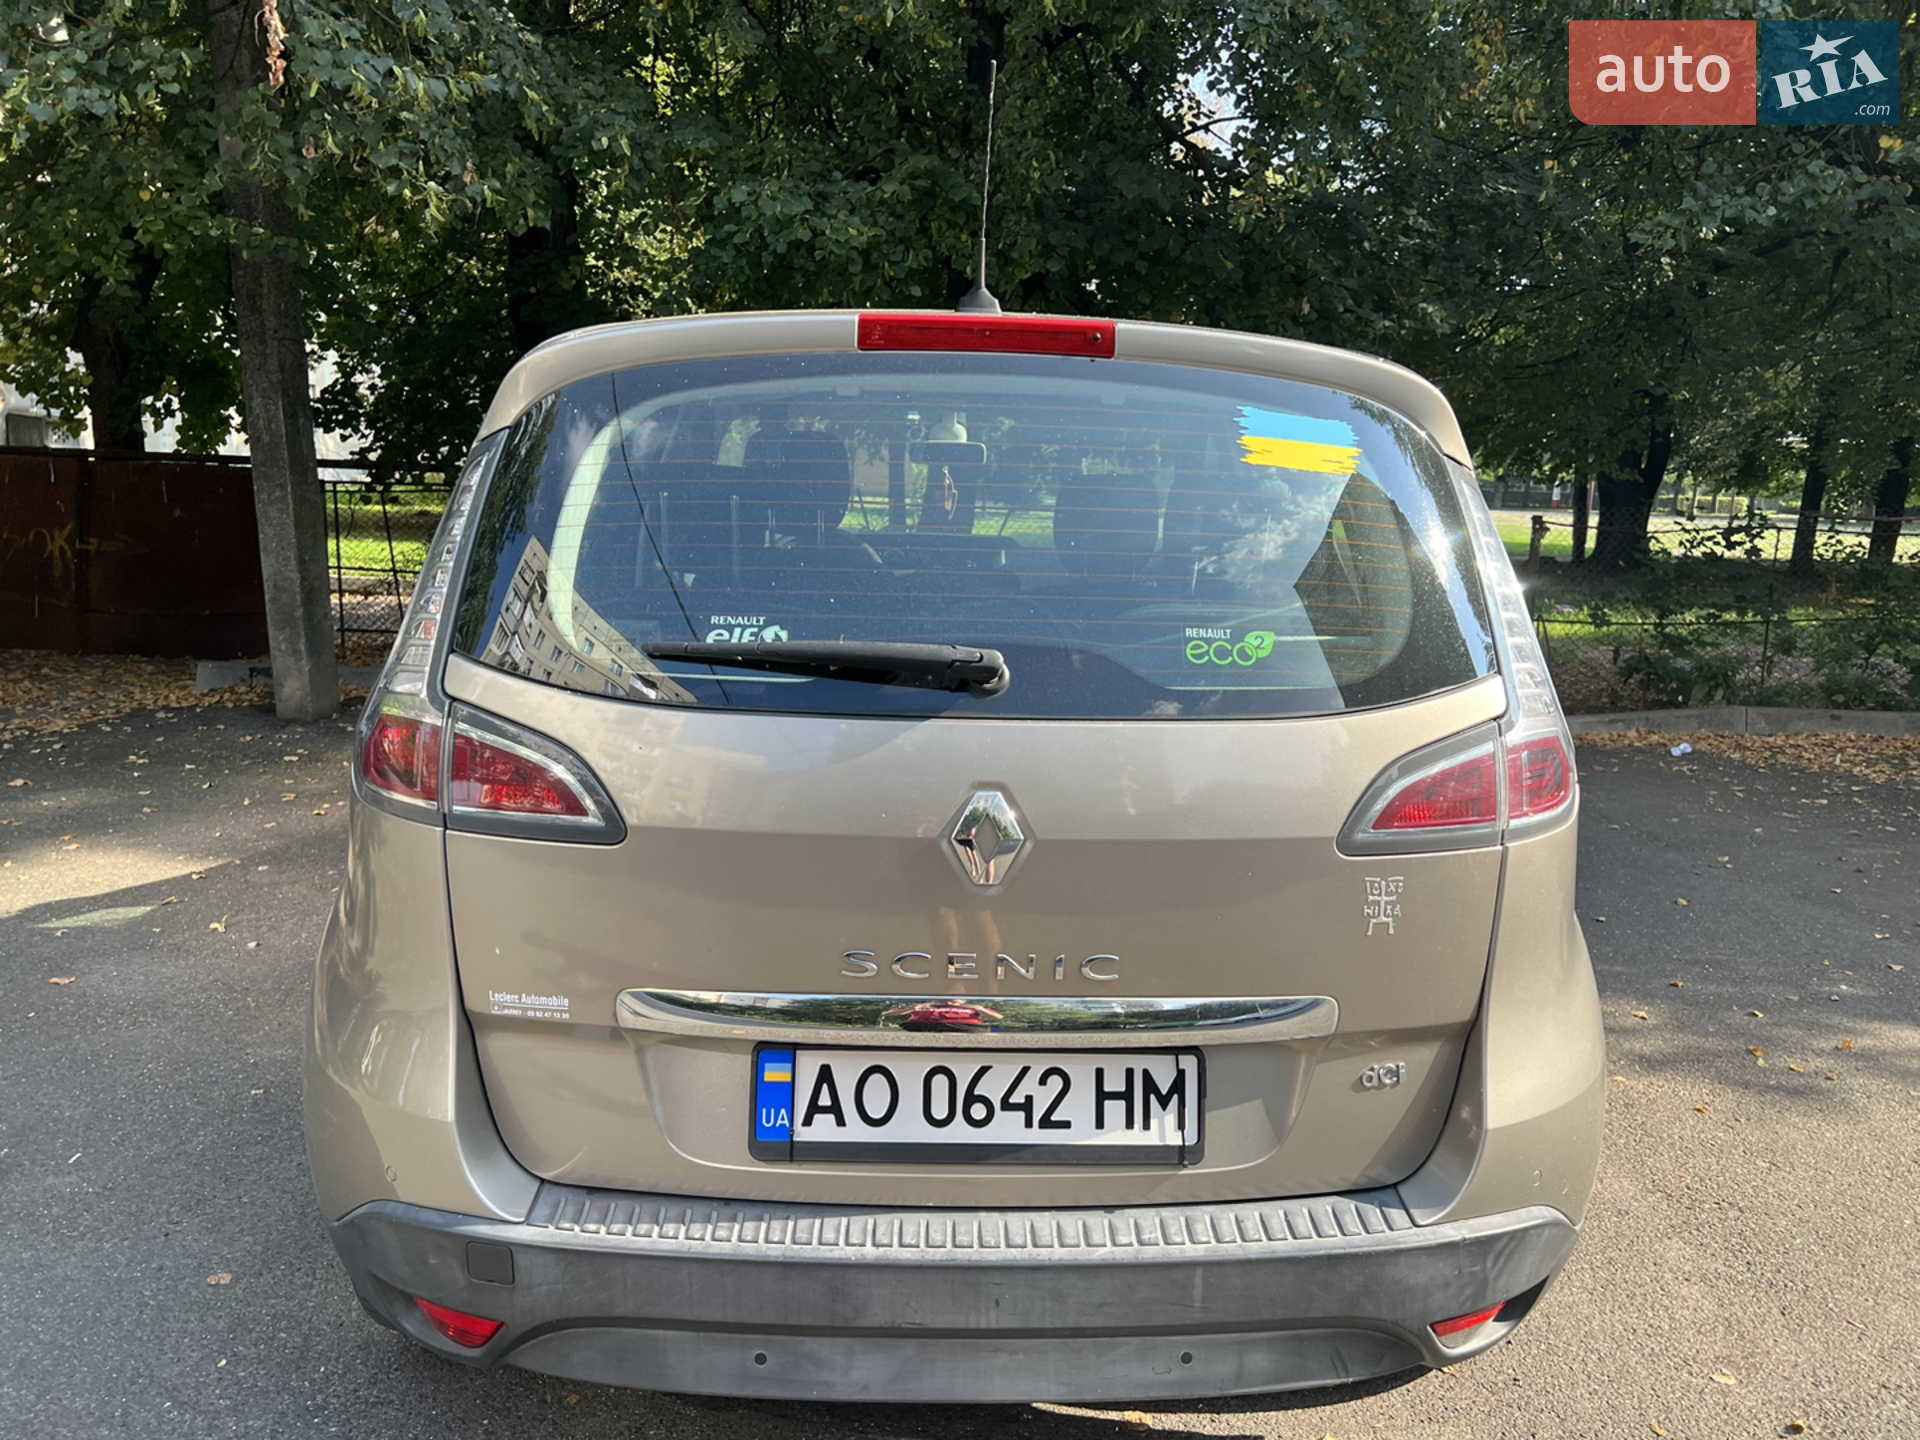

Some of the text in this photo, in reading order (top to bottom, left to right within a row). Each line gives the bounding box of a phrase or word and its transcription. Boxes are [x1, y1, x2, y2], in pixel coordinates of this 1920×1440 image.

[710, 615, 767, 626] RENAULT
[1185, 627, 1232, 639] RENAULT
[840, 950, 1120, 981] SCENIC
[488, 990, 570, 1007] Leclerc Automobile
[801, 1063, 1187, 1132] AO 0642 HM
[762, 1107, 790, 1129] UA
